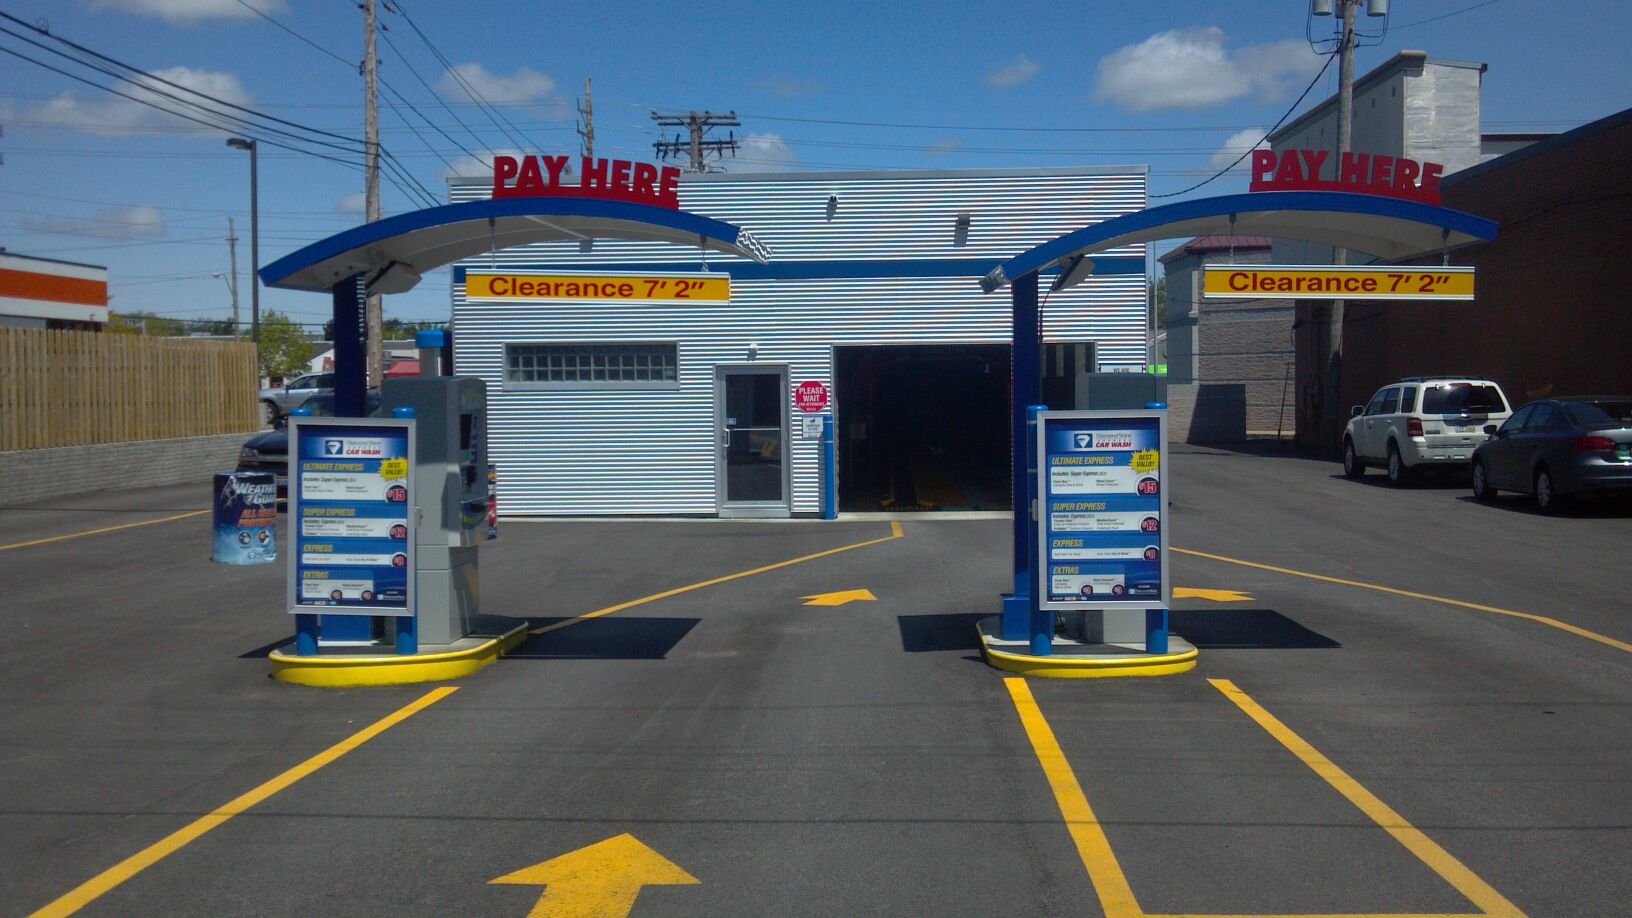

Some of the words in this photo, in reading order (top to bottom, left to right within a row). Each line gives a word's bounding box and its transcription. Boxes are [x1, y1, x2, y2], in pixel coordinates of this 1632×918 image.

[1252, 149, 1329, 185] PAY
[1340, 151, 1444, 198] HERE
[493, 155, 570, 190] PAY
[580, 156, 681, 204] HERE
[1228, 272, 1378, 292] Clearance
[488, 277, 634, 298] Clearance
[799, 387, 824, 395] PLEASE
[1052, 456, 1084, 465] ULTIMATE
[1084, 456, 1114, 465] EXPRESS
[1136, 460, 1155, 468] VALUE!
[1138, 481, 1158, 494] $15
[387, 489, 406, 501] $15
[1052, 502, 1076, 511] SUPER
[1076, 502, 1106, 511] EXPRESS
[1141, 519, 1158, 531] $12
[303, 544, 333, 552] EXPRESS
[1052, 539, 1083, 548] EXPRESS
[1053, 566, 1079, 574] EXTRAS
